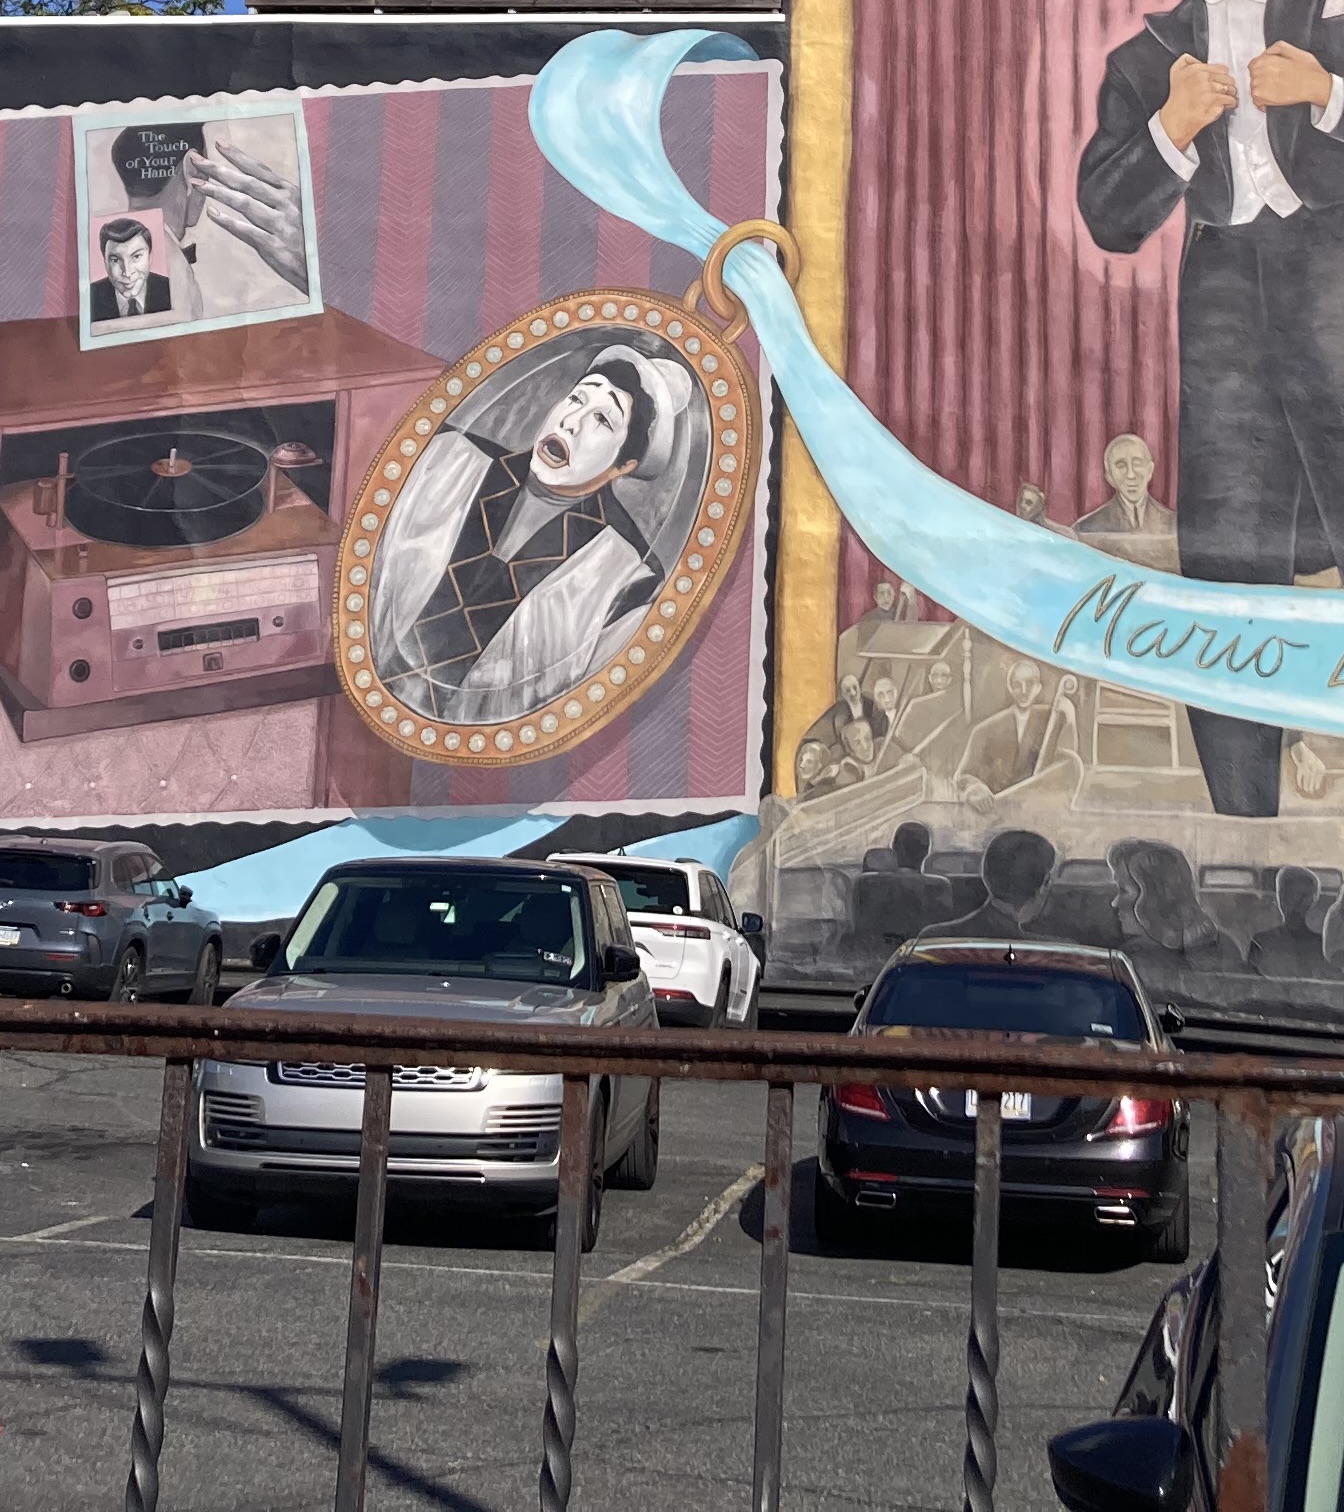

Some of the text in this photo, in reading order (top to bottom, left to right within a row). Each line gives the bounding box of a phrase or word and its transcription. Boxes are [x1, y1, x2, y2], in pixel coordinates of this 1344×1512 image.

[137, 131, 166, 143] The
[145, 139, 189, 154] Touch
[125, 155, 176, 169] of Your
[140, 165, 177, 179] Hand
[1053, 574, 1310, 679] Mario
